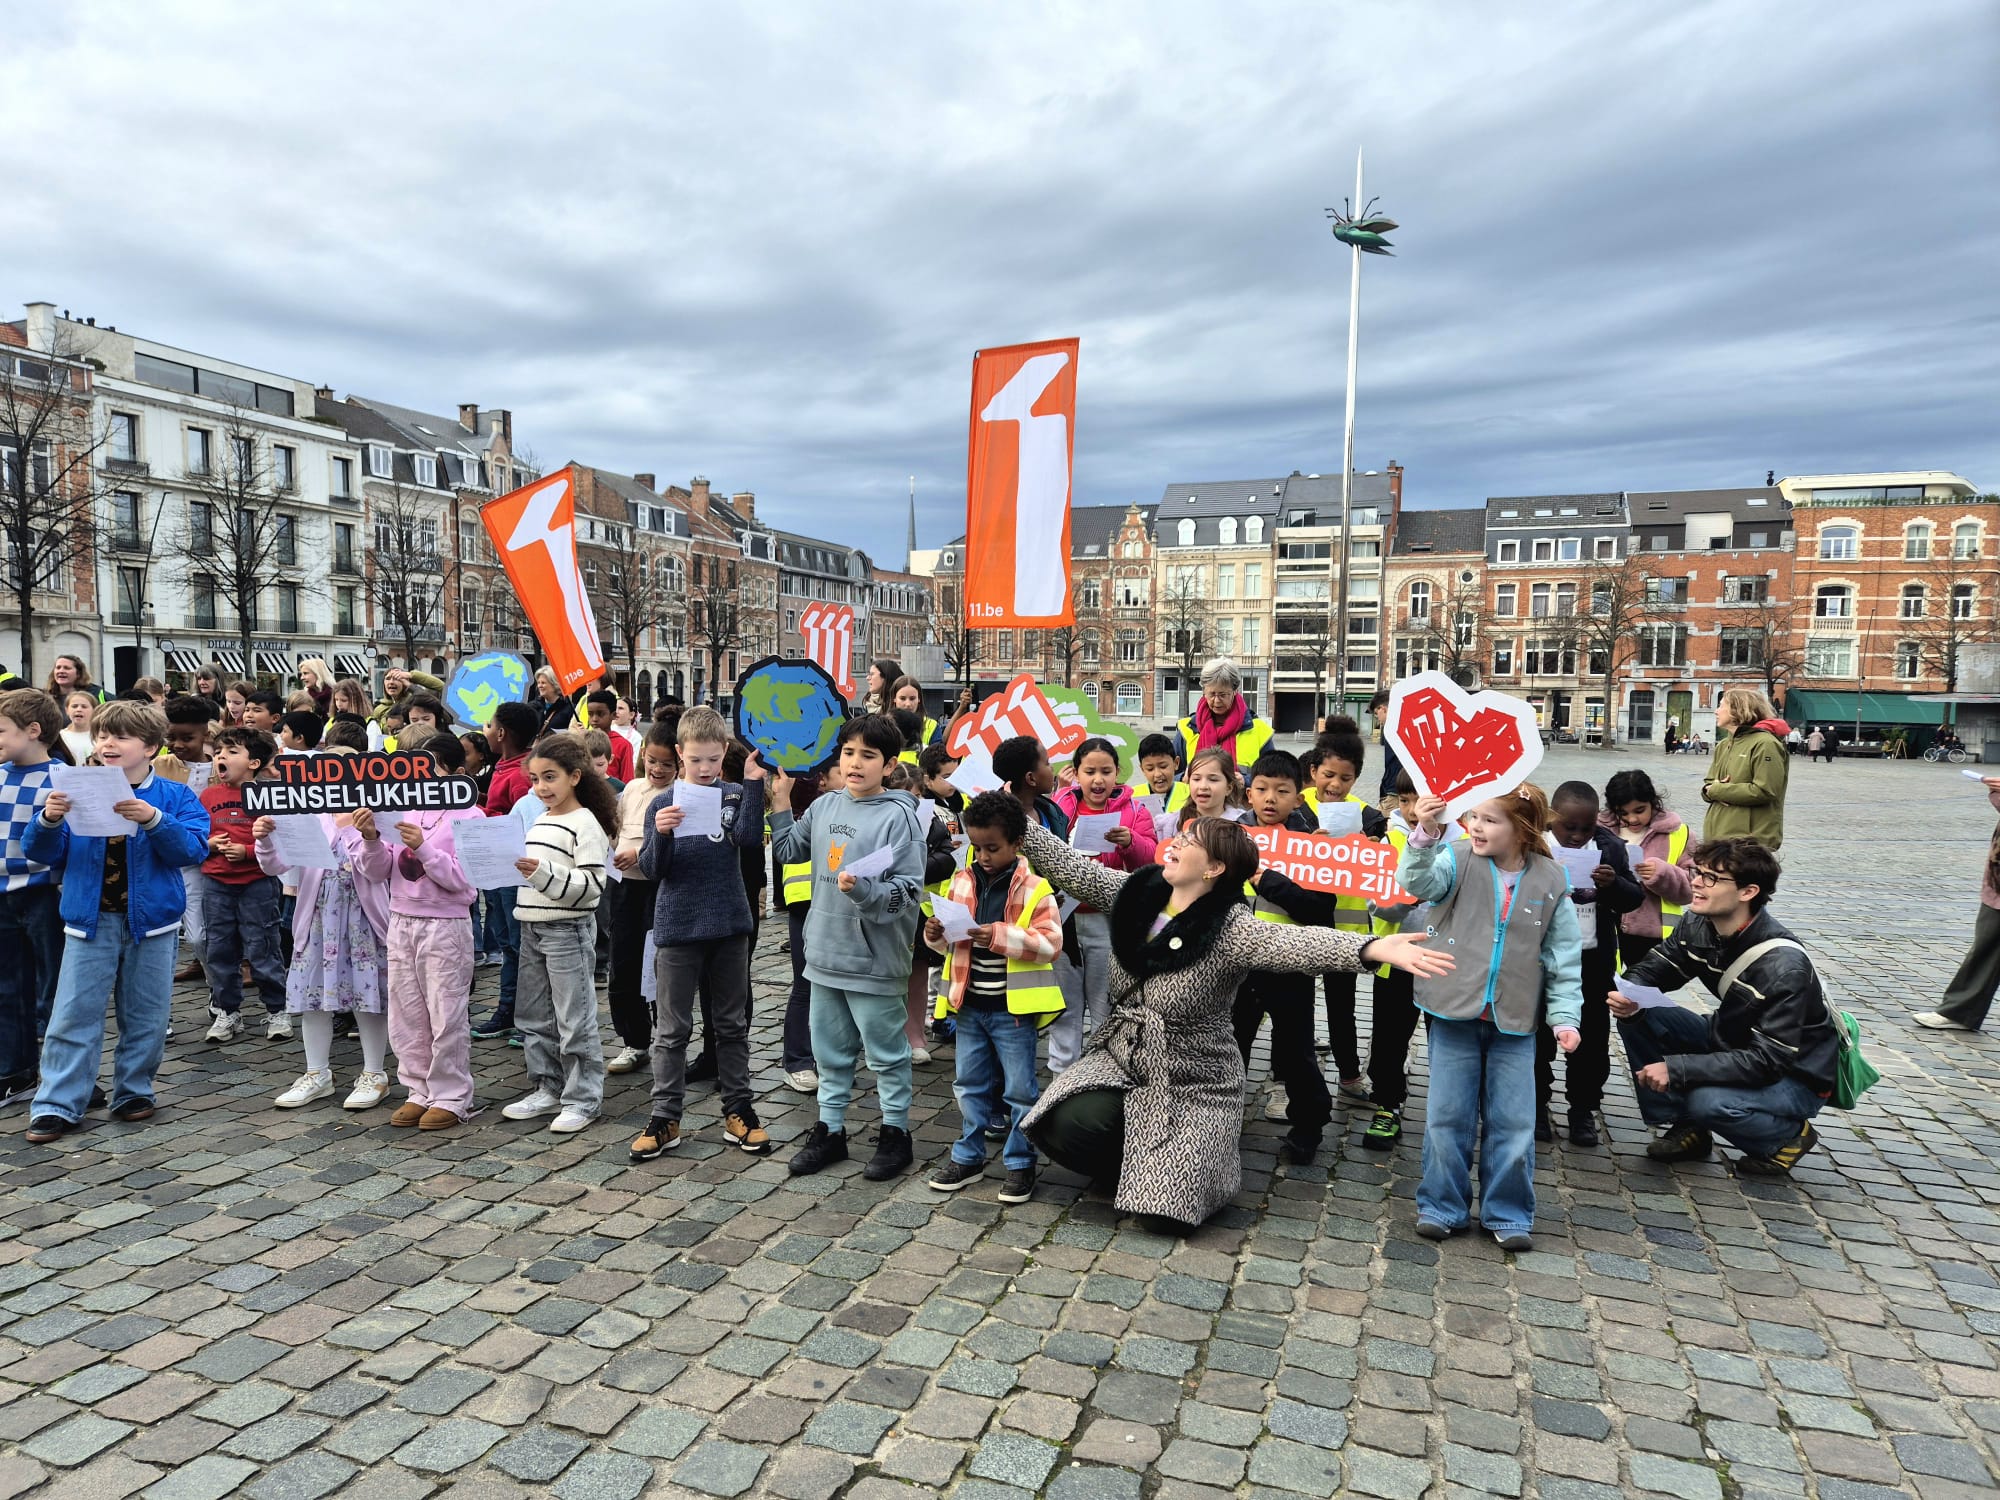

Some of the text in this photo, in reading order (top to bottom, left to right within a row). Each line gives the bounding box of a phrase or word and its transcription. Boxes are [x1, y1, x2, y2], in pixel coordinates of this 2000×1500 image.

[969, 602, 1004, 617] 11.be
[207, 639, 236, 649] DILLE
[349, 755, 432, 782] VOOR
[1286, 838, 1391, 868] mooier
[1257, 858, 1351, 888] samen
